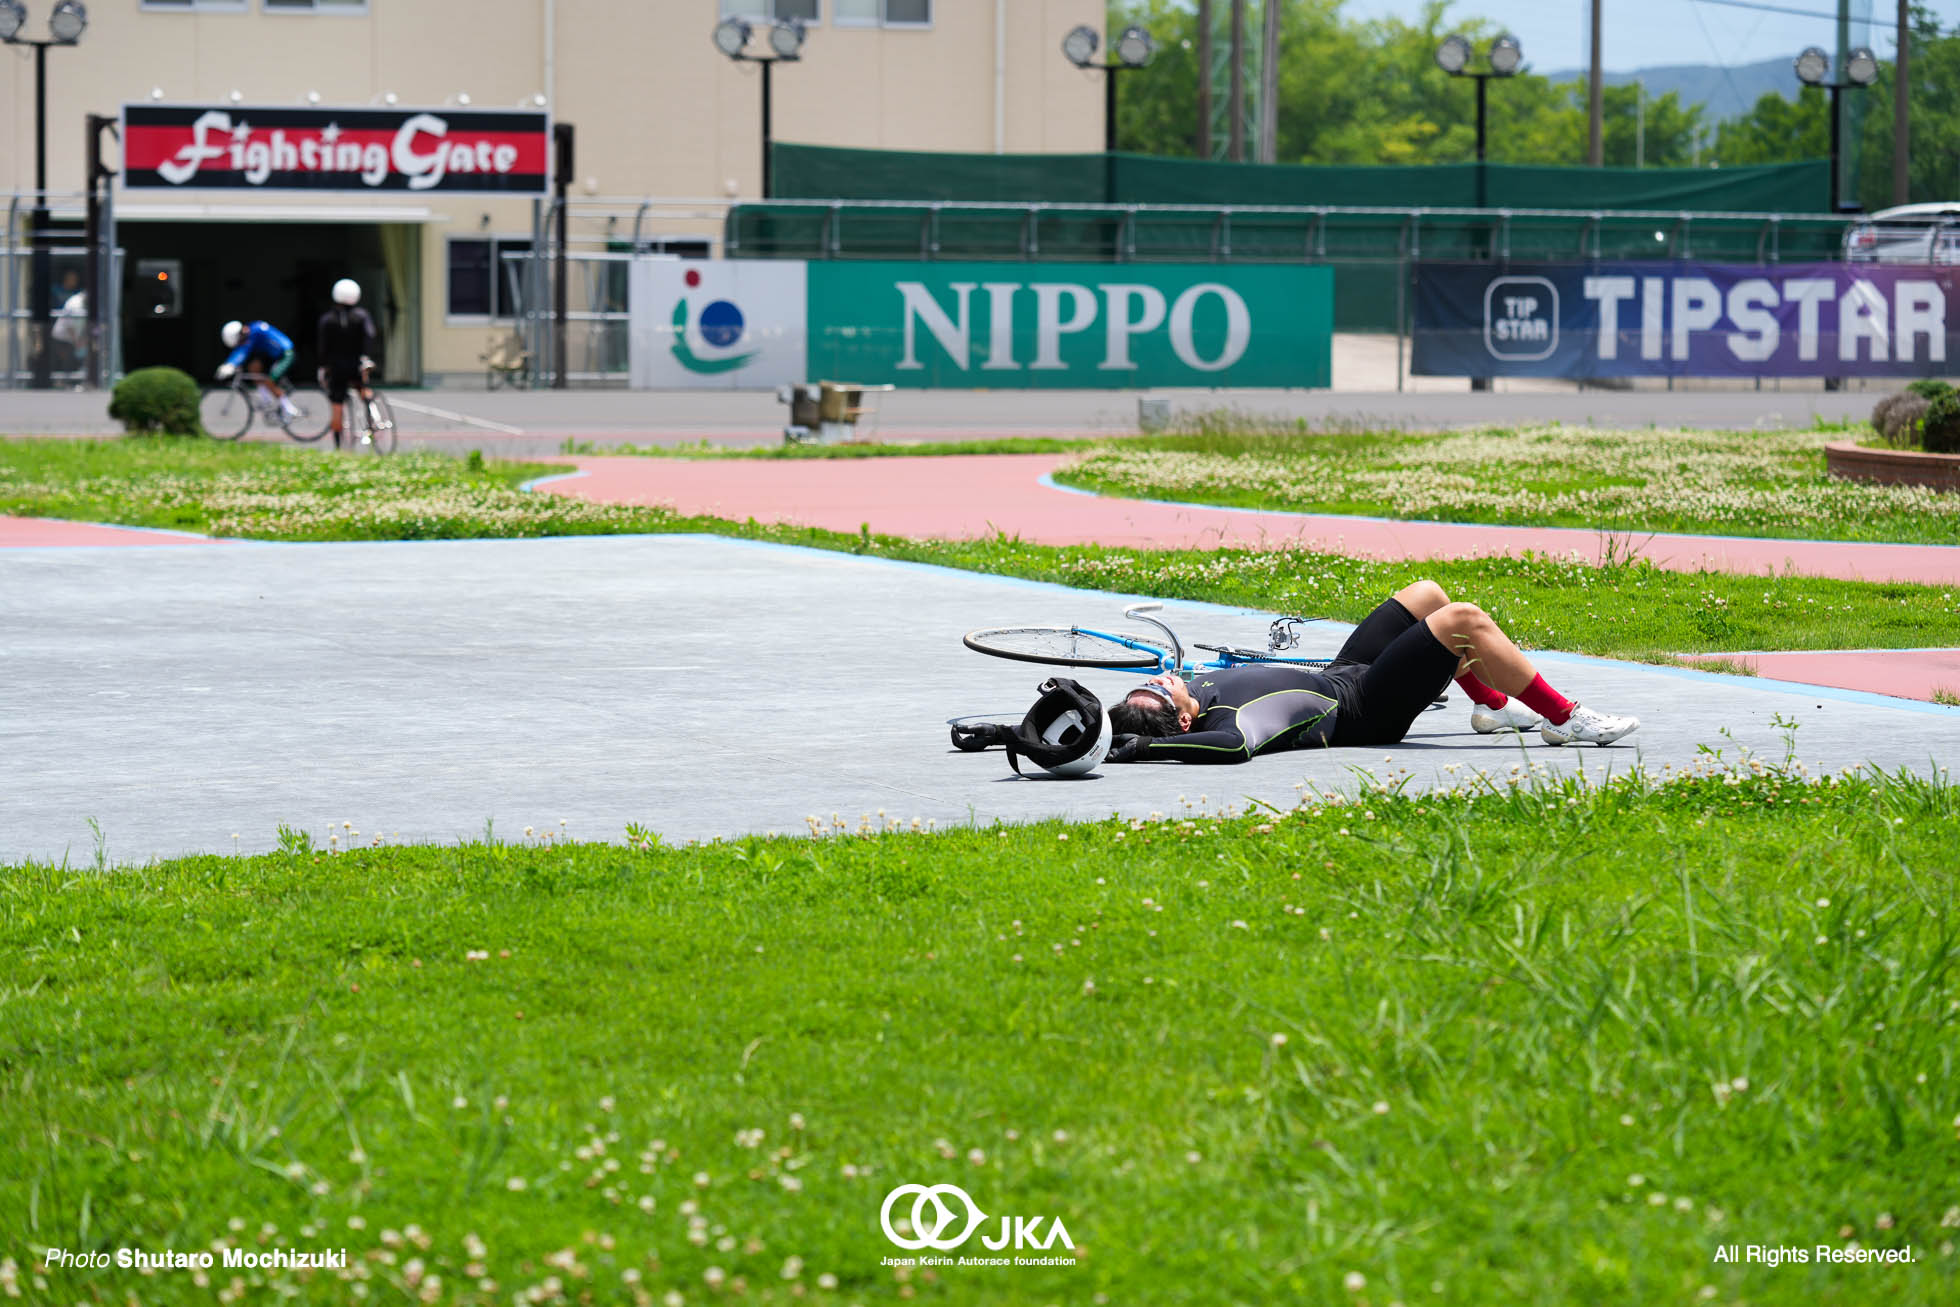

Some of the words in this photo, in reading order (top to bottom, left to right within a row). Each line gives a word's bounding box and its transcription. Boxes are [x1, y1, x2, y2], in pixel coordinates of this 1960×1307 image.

[158, 111, 388, 185] Fighting
[392, 114, 518, 190] Gate
[894, 281, 1251, 372] NIPPO
[1496, 319, 1548, 340] STAR
[1504, 297, 1538, 318] TIP
[1584, 276, 1946, 362] TIPSTAR
